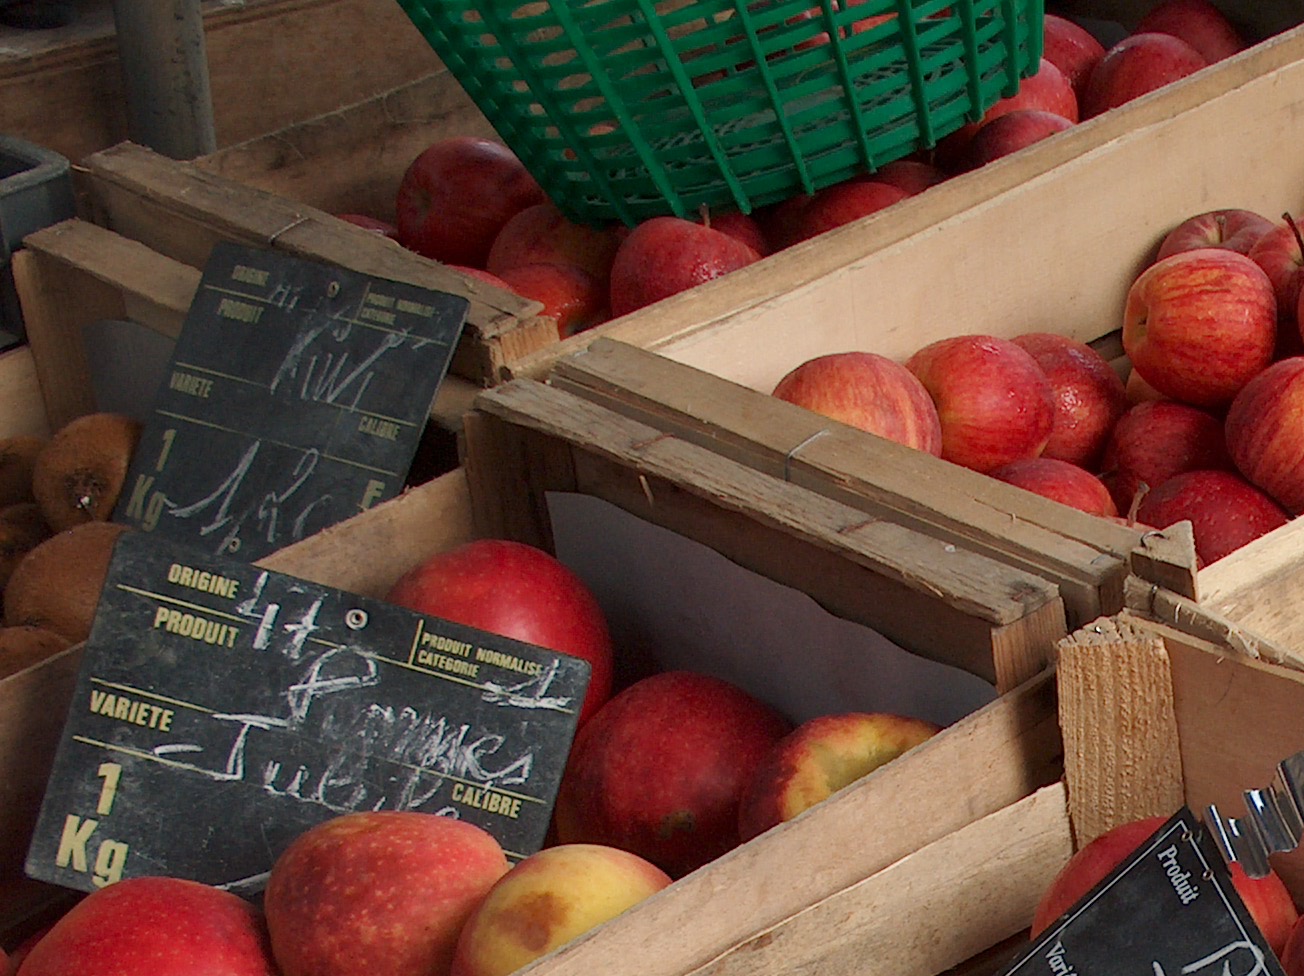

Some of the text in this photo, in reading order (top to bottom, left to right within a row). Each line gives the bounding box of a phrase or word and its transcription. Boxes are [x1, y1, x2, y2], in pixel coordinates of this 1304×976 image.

[156, 429, 177, 472] 1
[124, 473, 167, 532] Kg
[167, 562, 241, 600] ORIGINE
[153, 605, 240, 649] PRODUIT
[421, 631, 473, 658] PRODUIT
[417, 649, 481, 679] CATEGORIE
[89, 689, 175, 733] VARIETE
[280, 644, 535, 786] Pmmes
[96, 762, 123, 816] 1
[451, 782, 523, 820] CALIBRE
[56, 813, 129, 888] Kg
[1156, 844, 1200, 905] Produit
